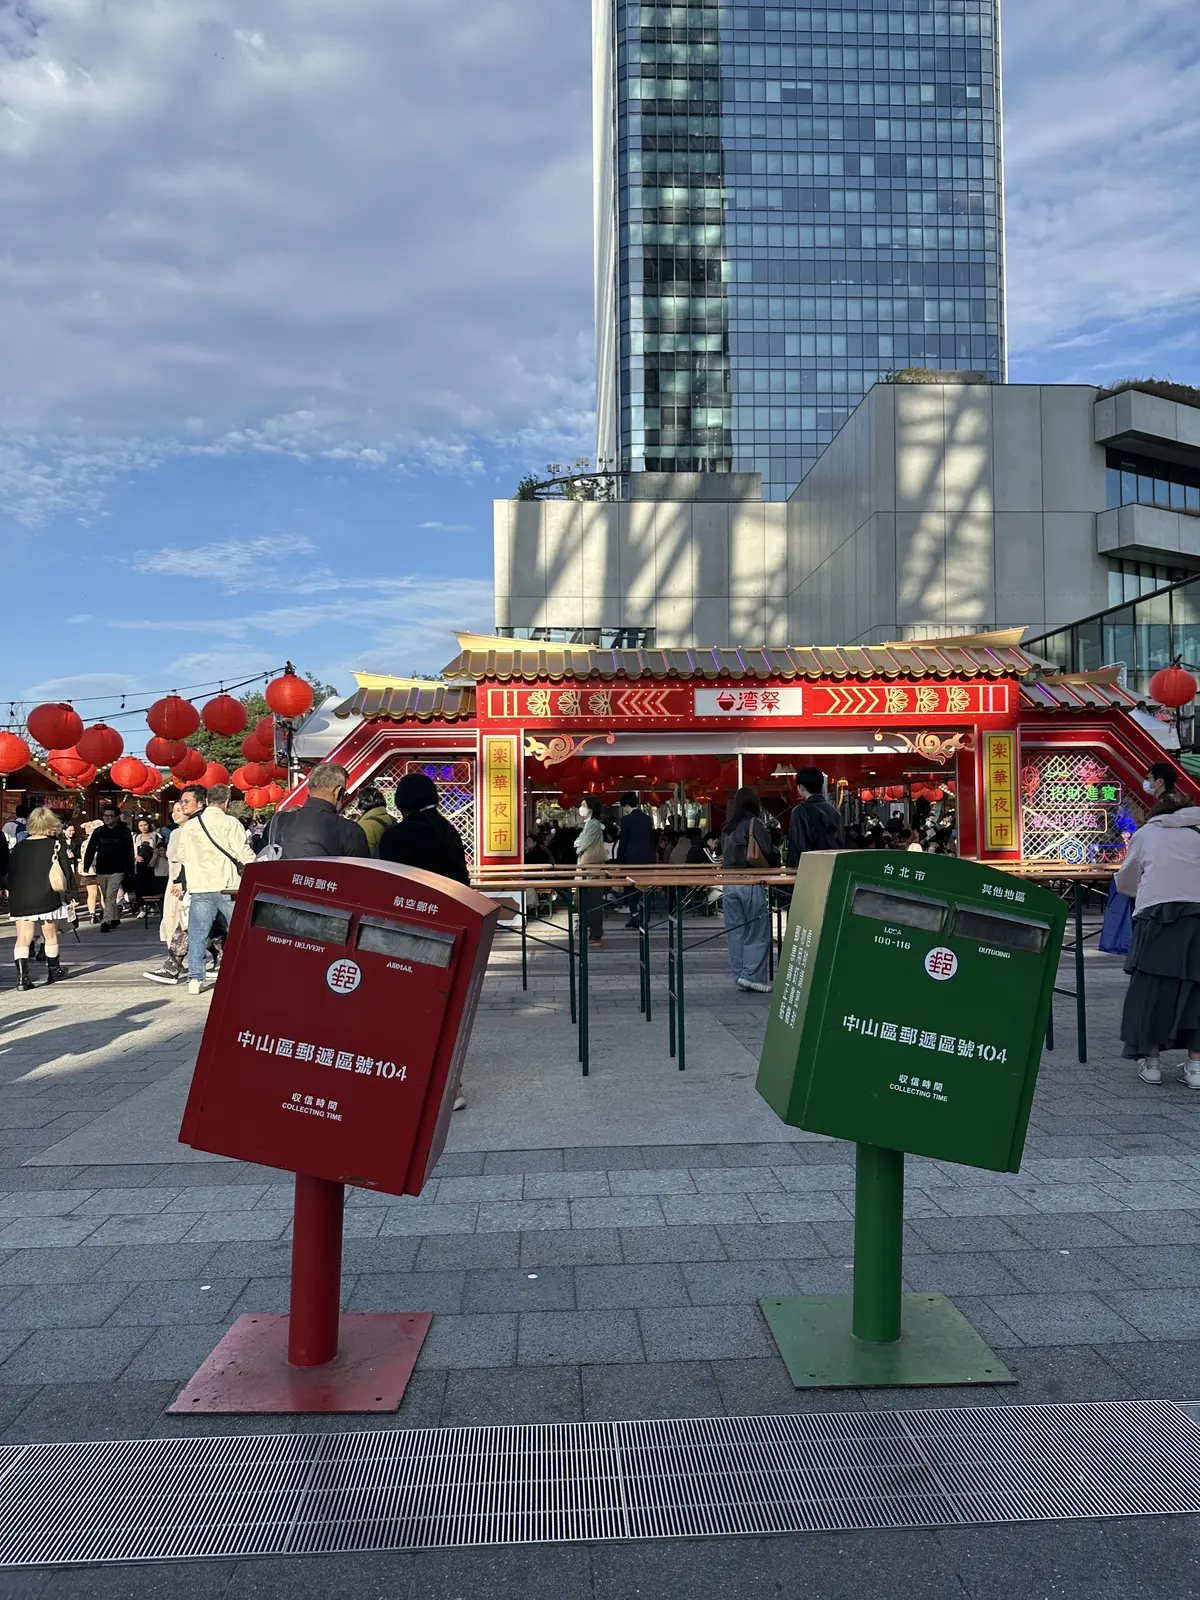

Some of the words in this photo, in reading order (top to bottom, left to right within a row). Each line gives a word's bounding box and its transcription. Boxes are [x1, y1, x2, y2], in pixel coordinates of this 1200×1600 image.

[716, 690, 780, 713] 台湾祭
[492, 747, 509, 845] 楽華夜市
[992, 741, 1009, 840] 楽華夜市
[1049, 784, 1116, 801] 招財進寶
[884, 864, 925, 880] 台北市
[292, 874, 338, 892] 限時郵件
[982, 884, 1025, 902] 其他地區
[393, 896, 439, 915] 航空郵件
[266, 935, 293, 946] PROMPT
[294, 941, 326, 953] DELIVERY
[874, 935, 911, 950] 100-116
[978, 946, 1011, 958] OUTGOING
[842, 1014, 1007, 1063] 中山區郵遞區號104
[237, 1030, 407, 1081] 中山區郵遞區號104
[890, 1083, 931, 1098] COLLECTING
[932, 1093, 948, 1102] TIME
[282, 1102, 325, 1117] COLLECTING
[326, 1112, 343, 1121] TIME
